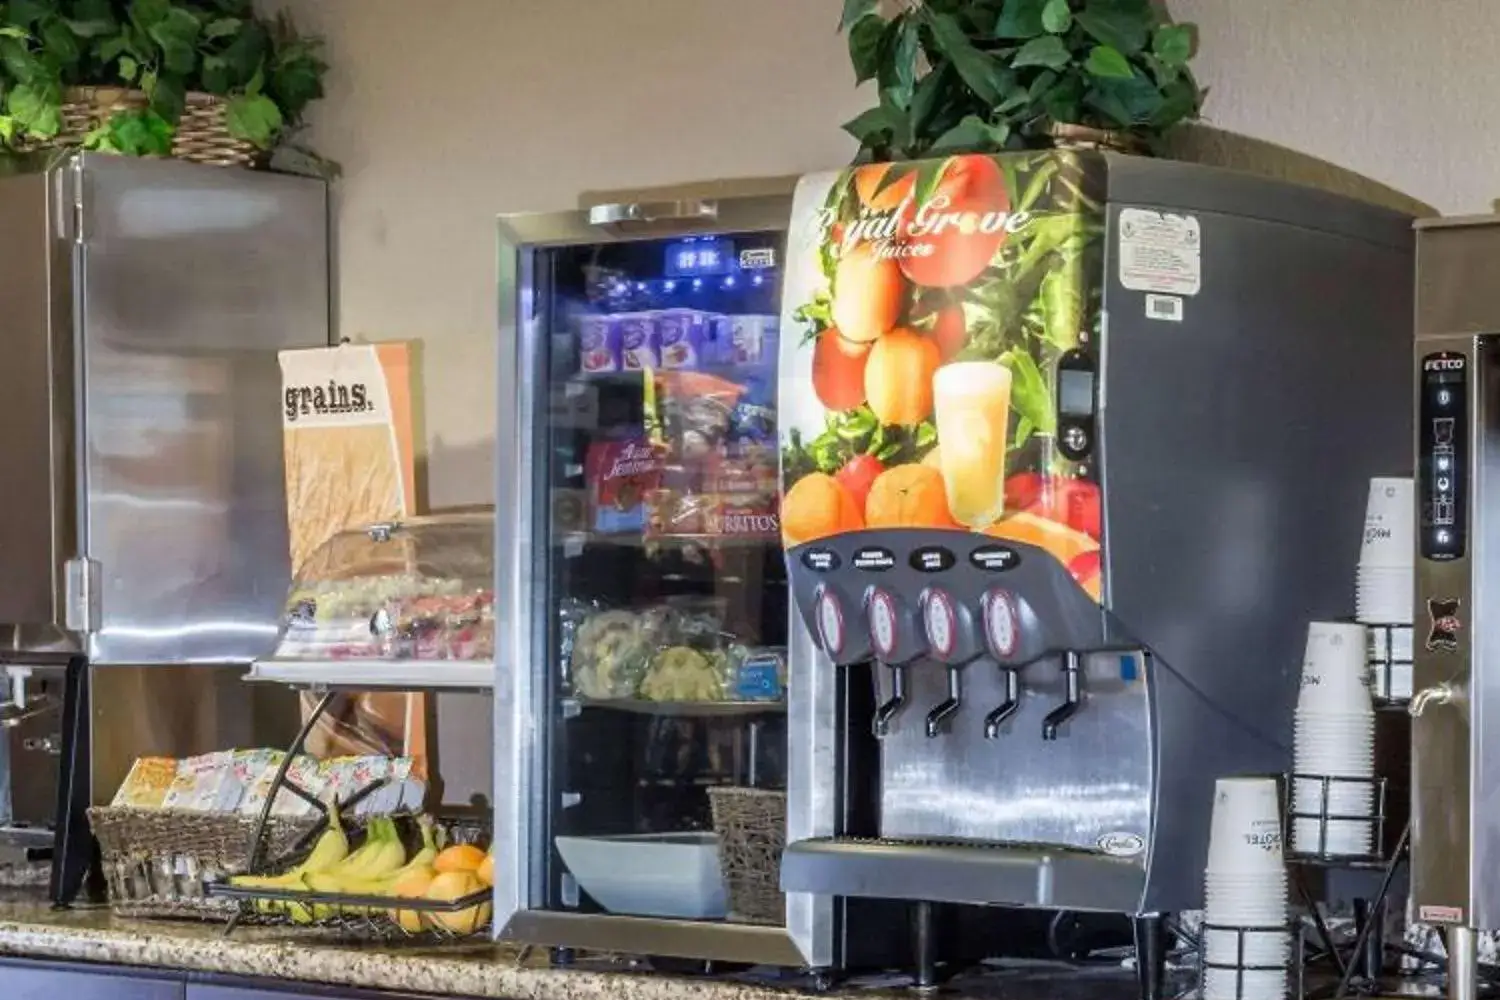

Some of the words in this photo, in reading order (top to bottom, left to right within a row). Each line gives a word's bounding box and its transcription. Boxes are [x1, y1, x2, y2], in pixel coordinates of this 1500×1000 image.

[906, 196, 1030, 238] Grove
[1424, 359, 1464, 371] FETCO
[285, 379, 374, 421] grains.
